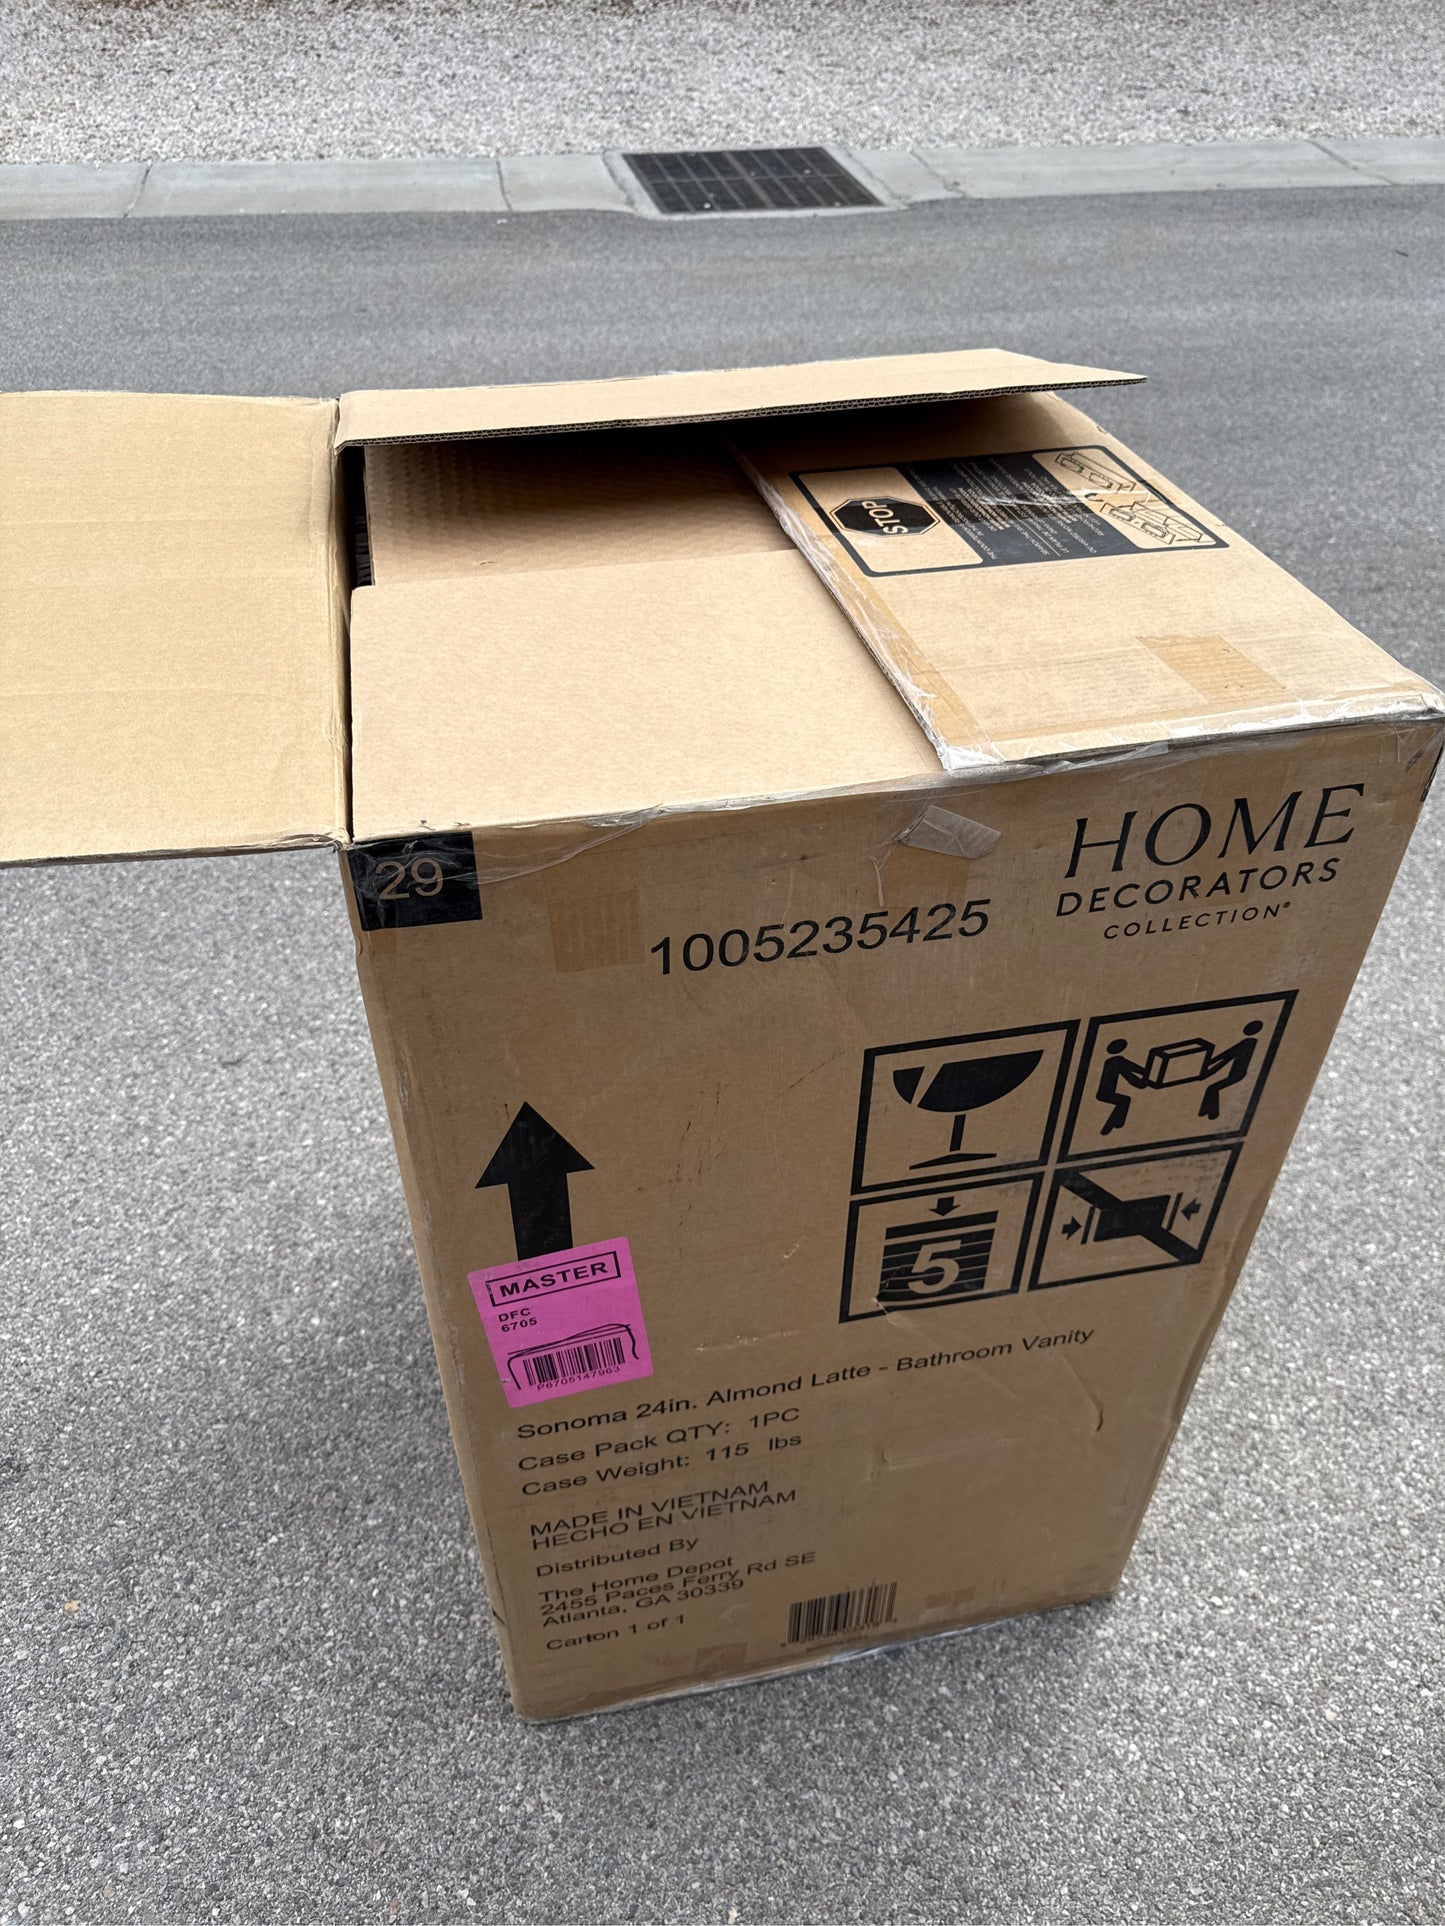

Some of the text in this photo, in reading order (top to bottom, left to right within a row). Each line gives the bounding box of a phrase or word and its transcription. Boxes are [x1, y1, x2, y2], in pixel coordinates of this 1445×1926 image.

[861, 500, 909, 534] STOP
[1064, 783, 1364, 878] HOME
[375, 857, 443, 900] 29
[1056, 857, 1340, 917] DECORATORS
[651, 898, 991, 975] 1005235425
[499, 1261, 609, 1298] MASTER
[498, 1307, 531, 1322] DFC
[501, 1317, 538, 1333] 6705
[517, 1410, 628, 1439] Sonoma
[636, 1398, 698, 1420] 24in.
[706, 1375, 803, 1407] Almond
[811, 1365, 871, 1388] Latte
[896, 1343, 1013, 1372] Bathroom
[1021, 1329, 1095, 1351] Vanity
[536, 1366, 621, 1391] P6705147963
[518, 1407, 800, 1471] Case Pack QTY: 1PC
[521, 1435, 802, 1496] Case Weight: 115 lbs
[530, 1480, 769, 1537] MADE IN VIETNAM
[532, 1489, 796, 1551] HECHO EN VIETNAM
[536, 1537, 699, 1578] Distributed By
[538, 1556, 733, 1603] The Home Depot
[540, 1551, 816, 1616] 2455 Paces Ferry Rd SE
[542, 1578, 744, 1628] Atlanta, GA 30339
[546, 1613, 686, 1650] Carton 1 of 1
